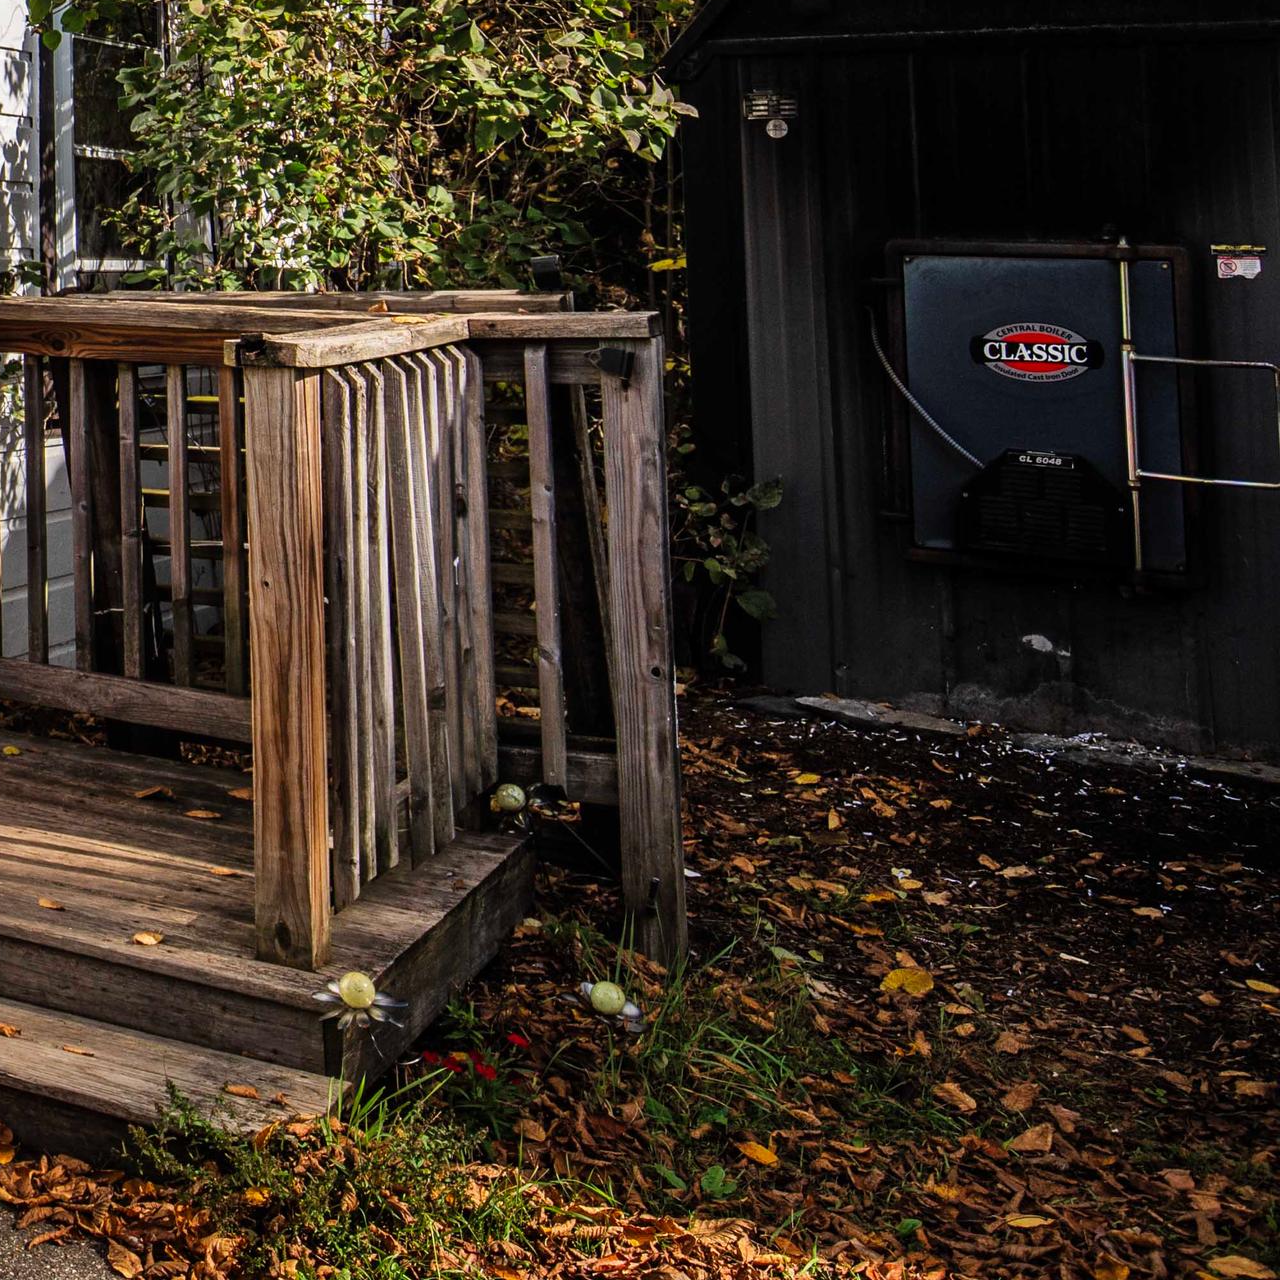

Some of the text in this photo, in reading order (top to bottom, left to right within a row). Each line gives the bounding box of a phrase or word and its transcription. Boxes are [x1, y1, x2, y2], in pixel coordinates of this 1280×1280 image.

[996, 324, 1073, 340] CENTRAL BOILER
[983, 341, 1088, 363] CLASSIC
[993, 363, 1026, 379] Insulated
[1027, 373, 1044, 381] Cast
[1035, 456, 1062, 466] 6048
